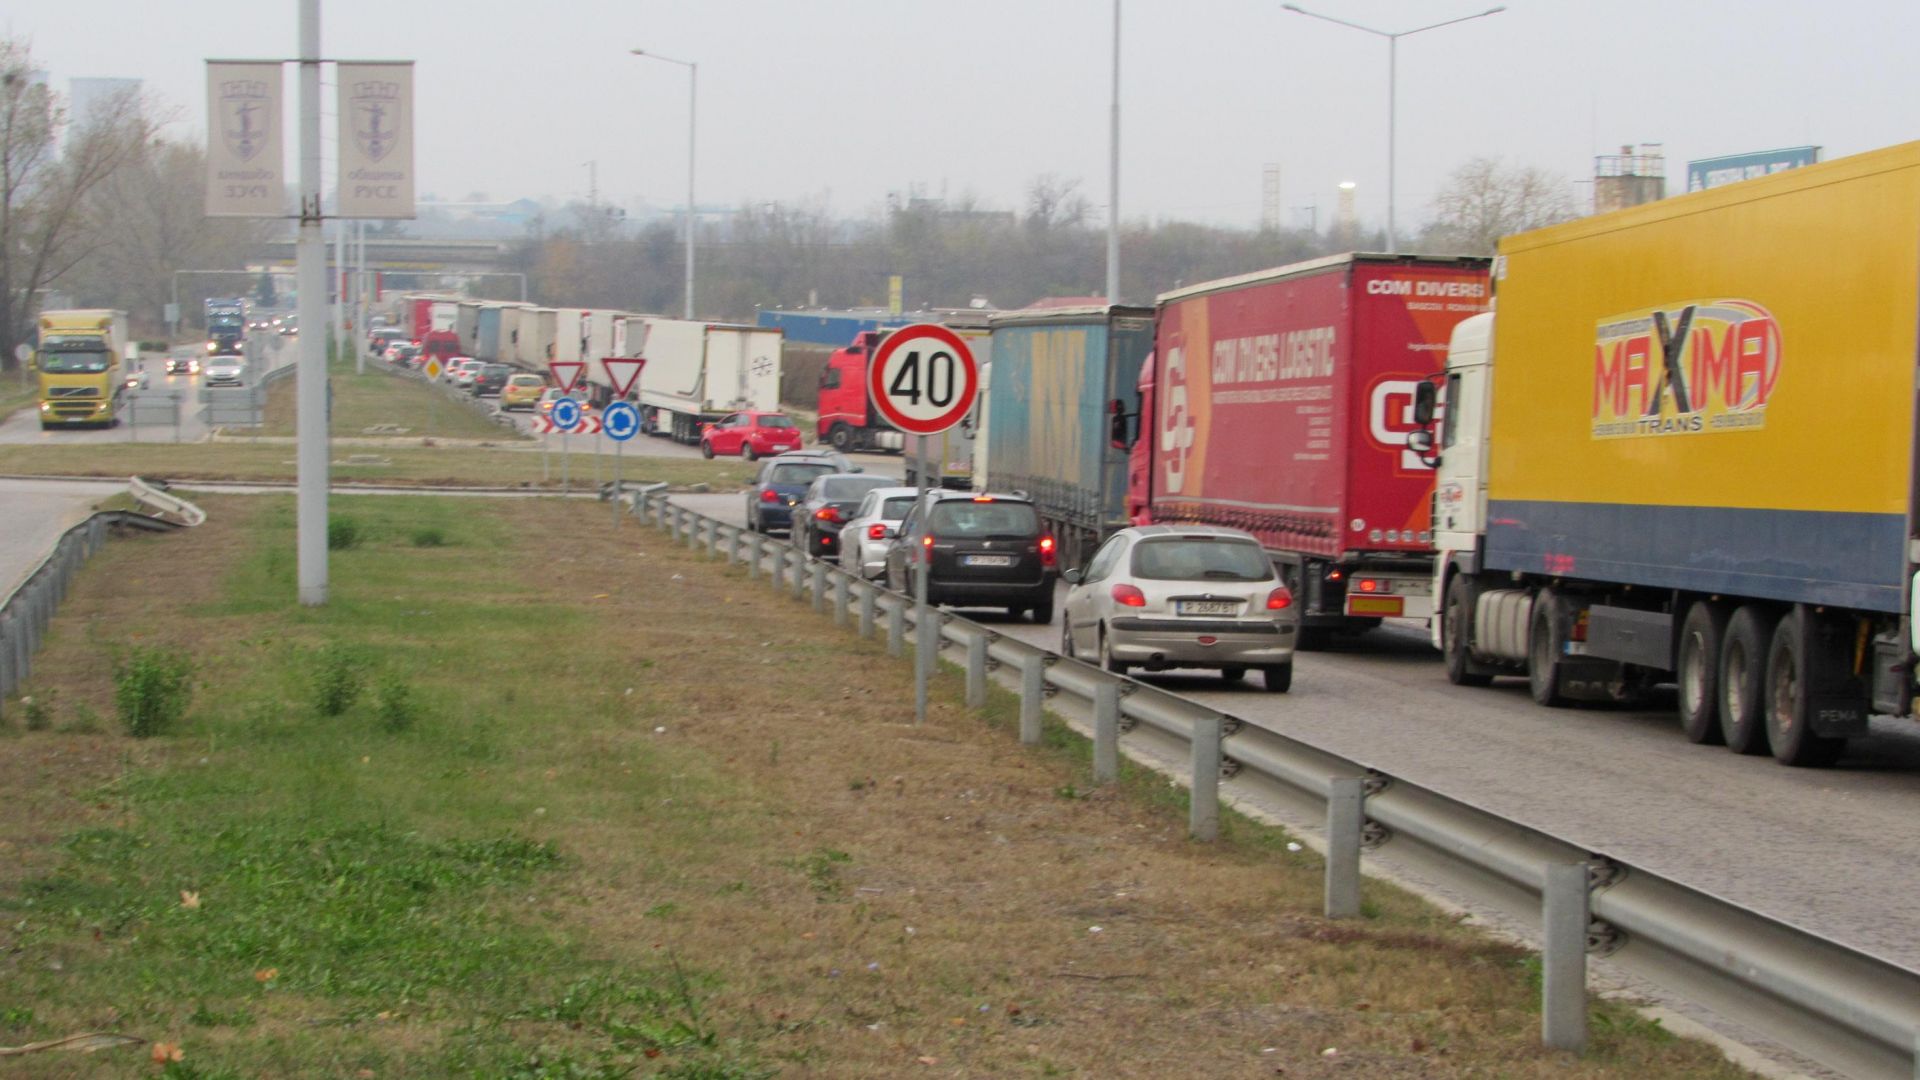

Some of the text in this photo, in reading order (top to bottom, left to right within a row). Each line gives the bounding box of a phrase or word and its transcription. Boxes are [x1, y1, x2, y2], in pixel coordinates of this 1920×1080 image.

[354, 186, 399, 199] РУСЕ
[1367, 280, 1484, 297] COM DIVERS
[1213, 326, 1336, 384] COM DIVERS LOGISTIC
[1592, 306, 1769, 418] MAXIMA
[890, 351, 954, 408] 40
[1638, 416, 1703, 435] TRANS
[1819, 709, 1858, 721] PEMA
